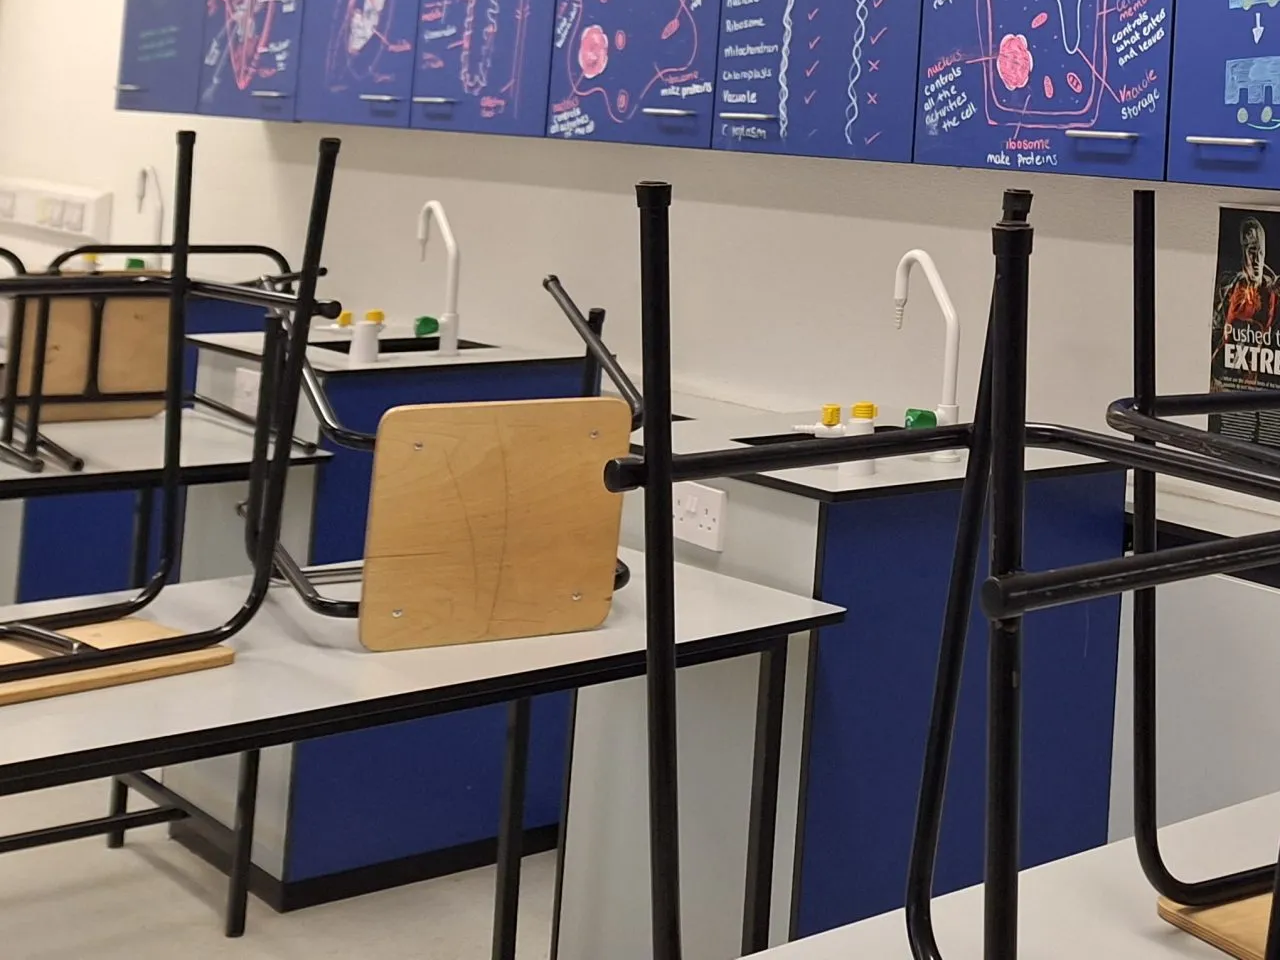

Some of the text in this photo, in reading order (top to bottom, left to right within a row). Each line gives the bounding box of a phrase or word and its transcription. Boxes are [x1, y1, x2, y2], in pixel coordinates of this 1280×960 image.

[1116, 30, 1141, 53] what
[1118, 47, 1138, 67] and
[961, 102, 977, 121] cell
[987, 151, 1011, 165] make
[1223, 323, 1272, 345] Pushed
